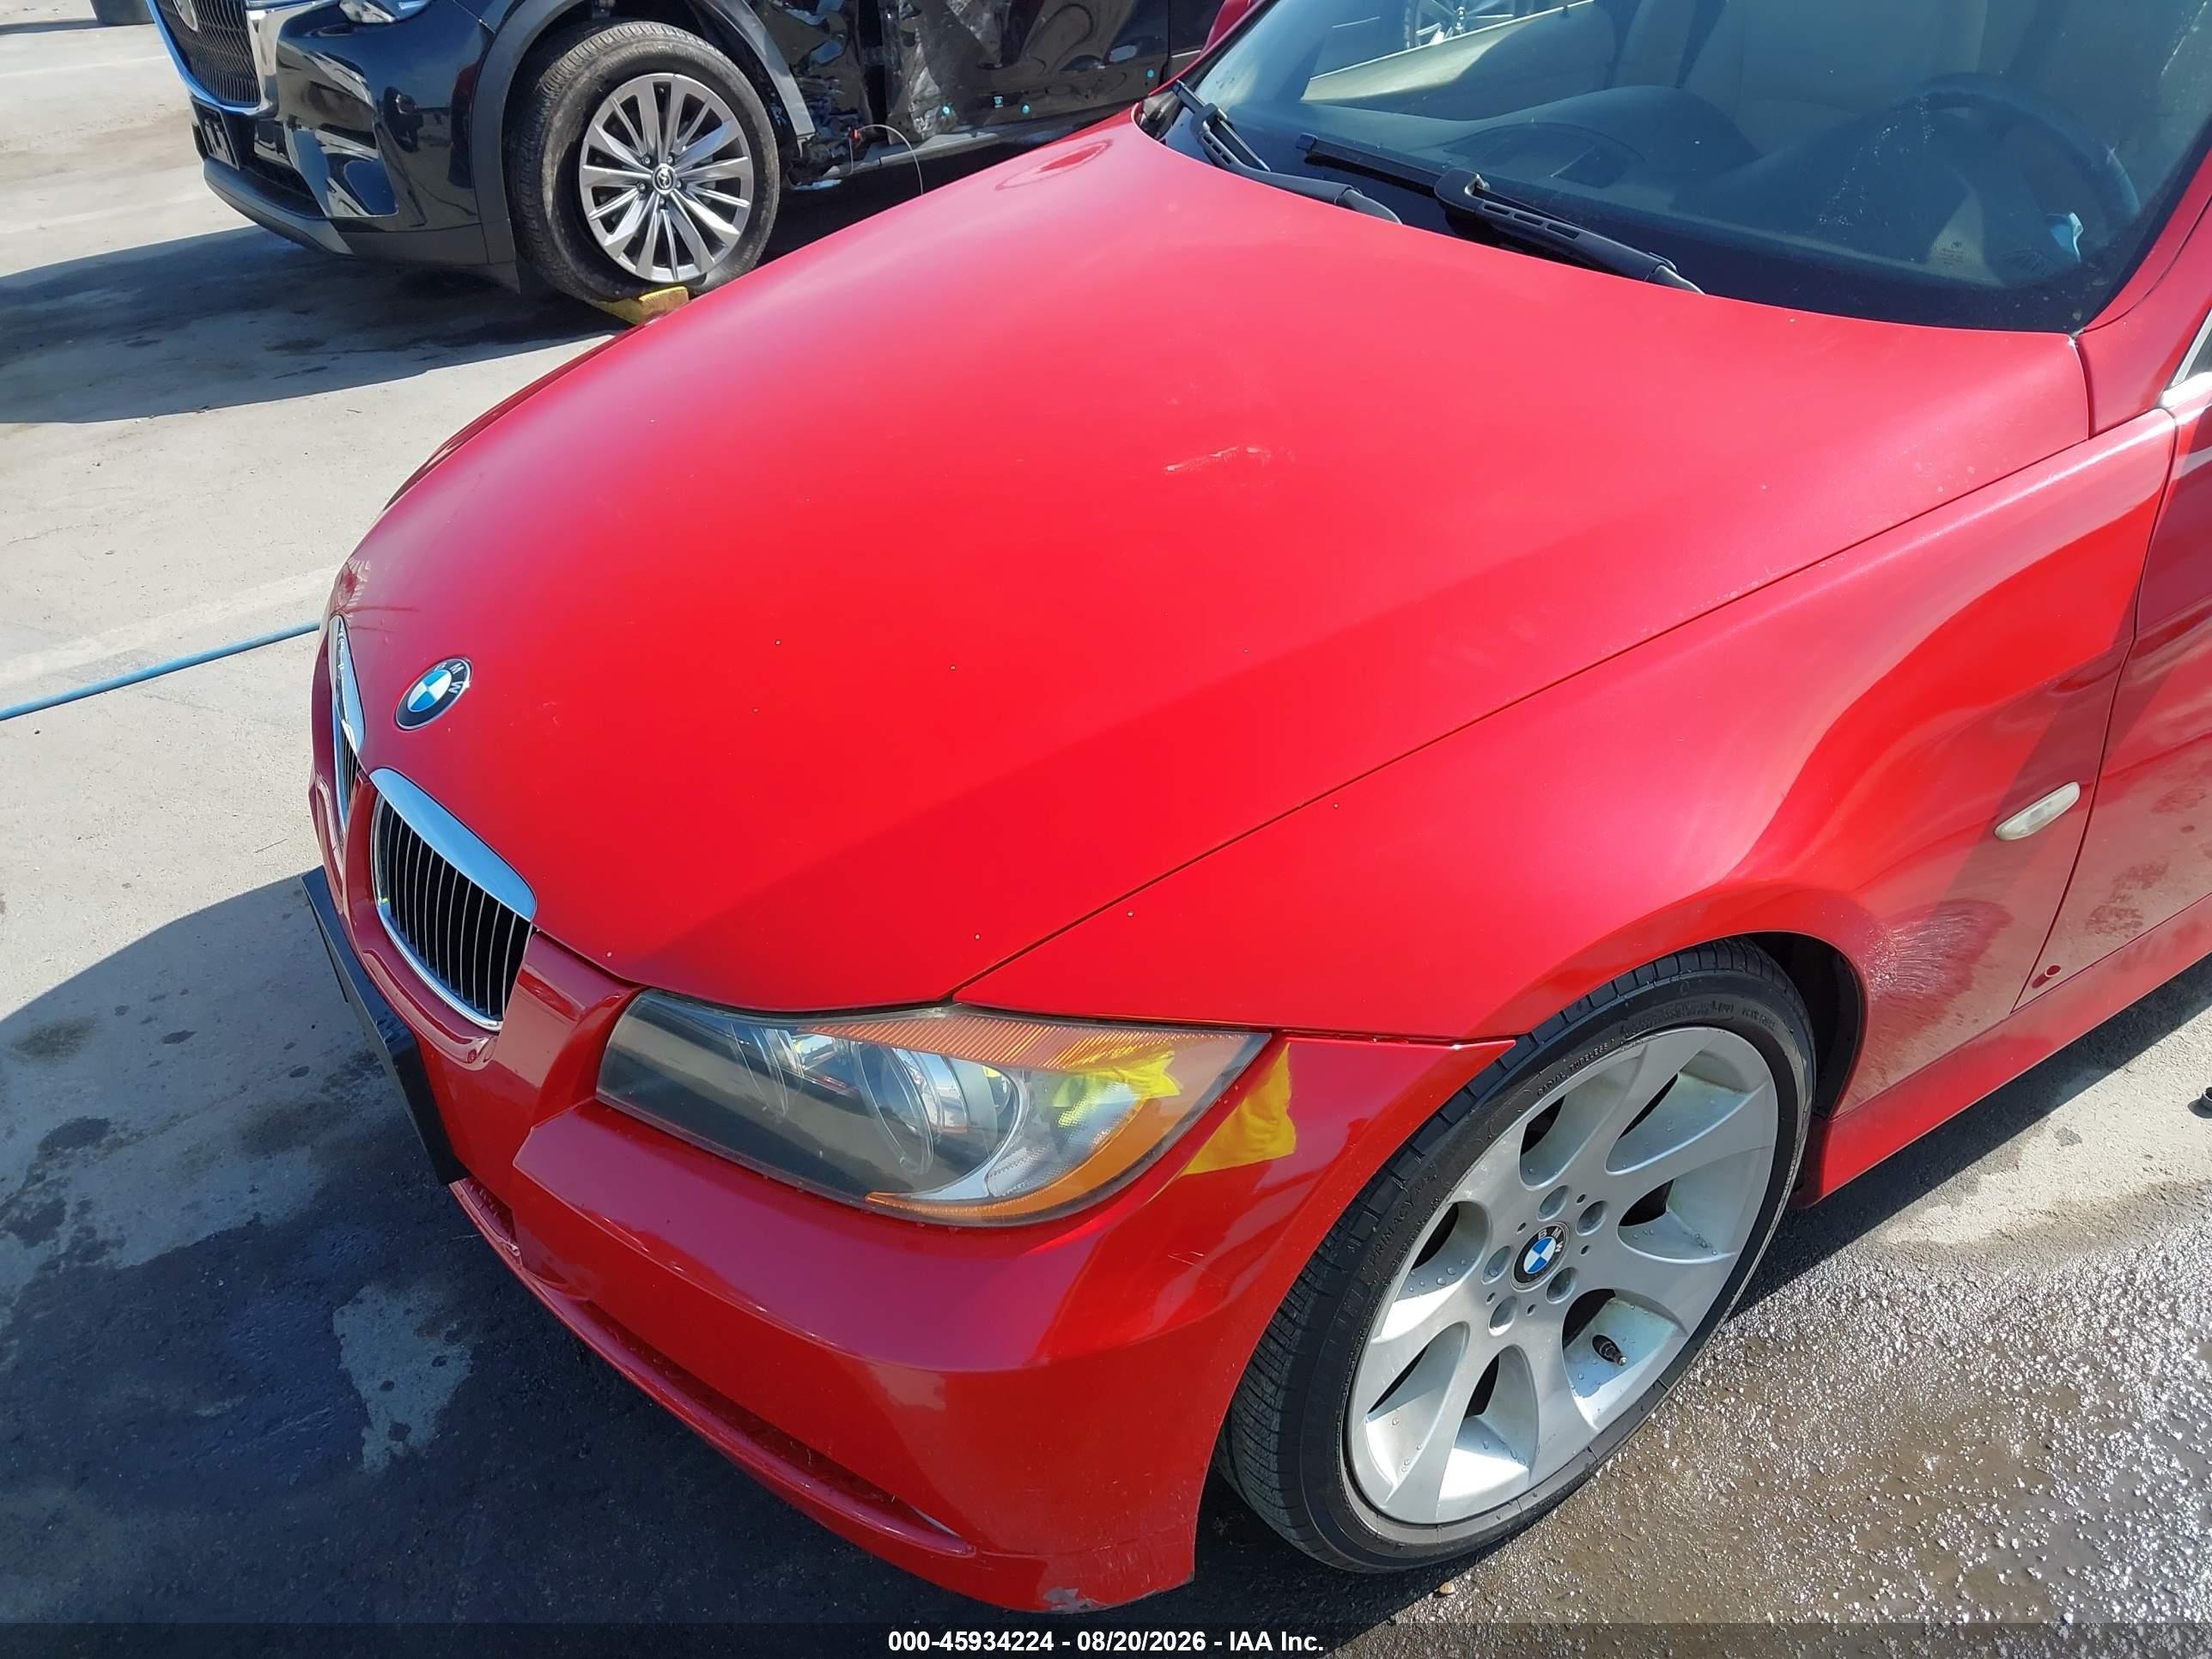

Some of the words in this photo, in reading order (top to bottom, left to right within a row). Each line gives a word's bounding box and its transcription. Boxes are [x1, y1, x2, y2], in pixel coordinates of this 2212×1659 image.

[434, 661, 465, 695] BMW
[1537, 1072, 1566, 1097] RADIAL
[1569, 1042, 1609, 1073] TUBELESS
[1368, 1200, 1415, 1266] PRIMACY
[1537, 1226, 1565, 1254] BMW
